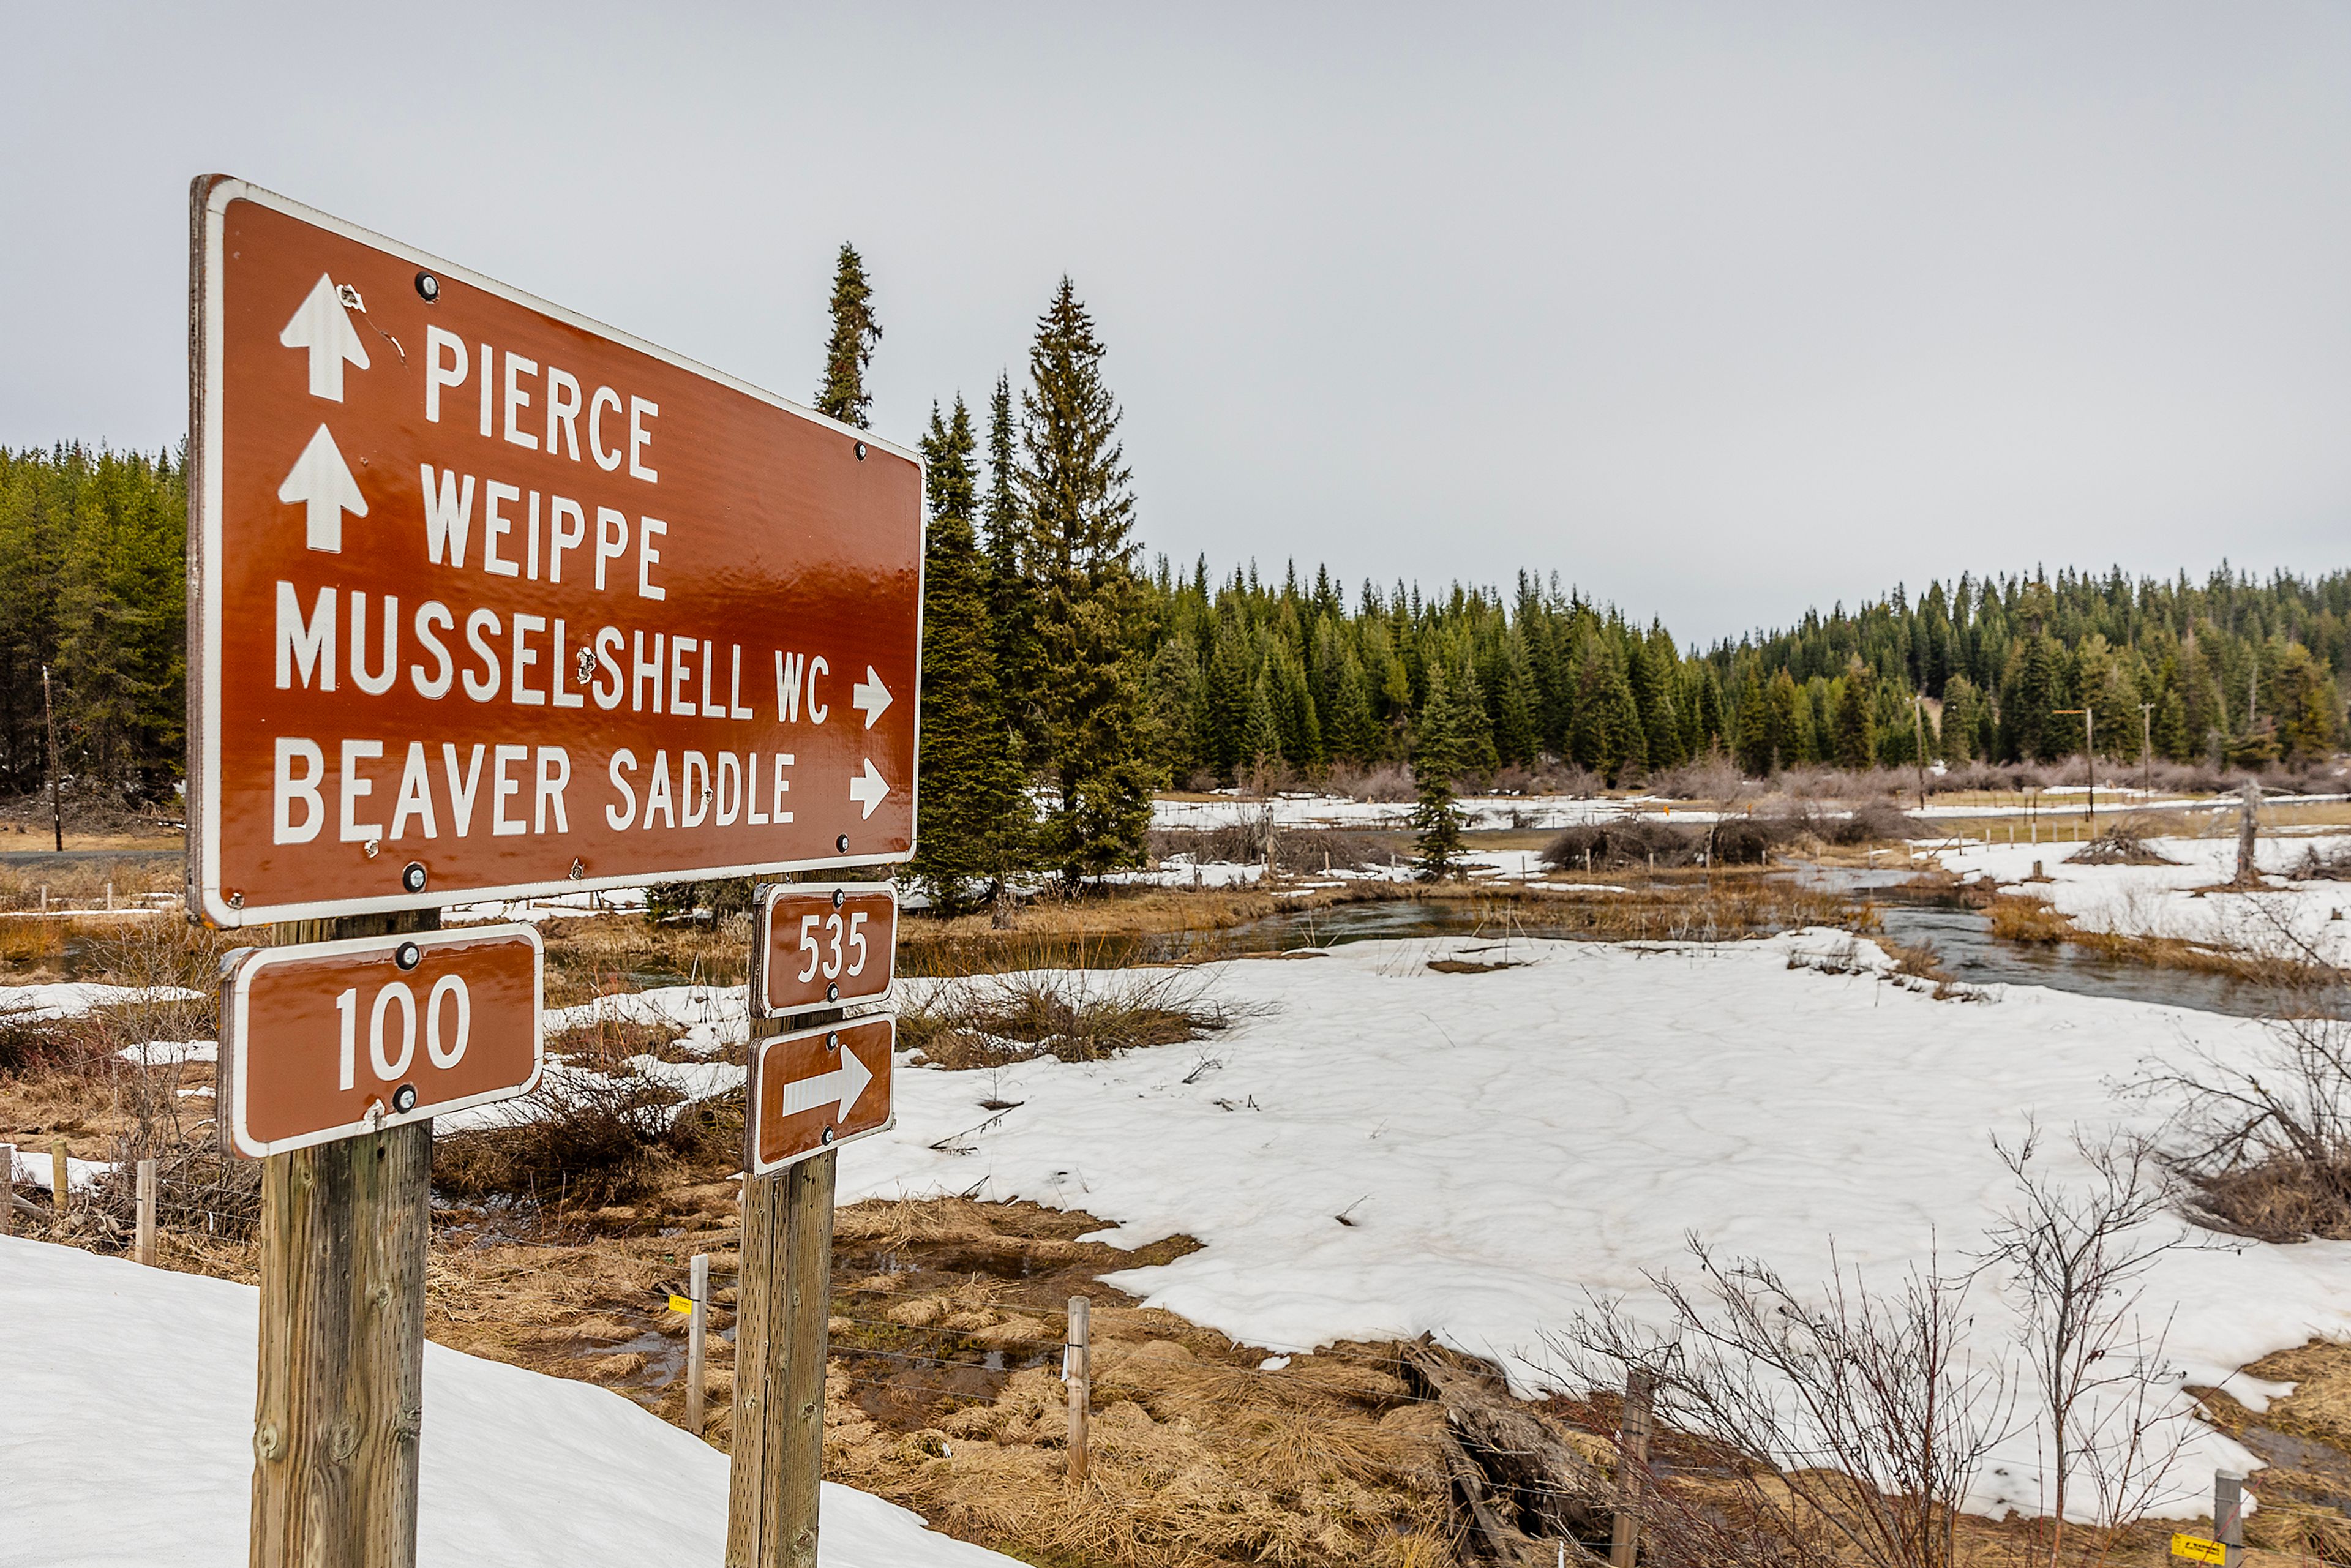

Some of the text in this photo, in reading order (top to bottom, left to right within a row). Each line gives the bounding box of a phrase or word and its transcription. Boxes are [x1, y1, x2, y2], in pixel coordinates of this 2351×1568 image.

[425, 324, 659, 484] PIERCE
[421, 463, 667, 601] WEIPPE
[276, 580, 829, 724] MUSSELSHELL WC
[274, 737, 795, 845] BEAVER SADDLE
[797, 912, 868, 983] 535
[336, 975, 470, 1090] 100
